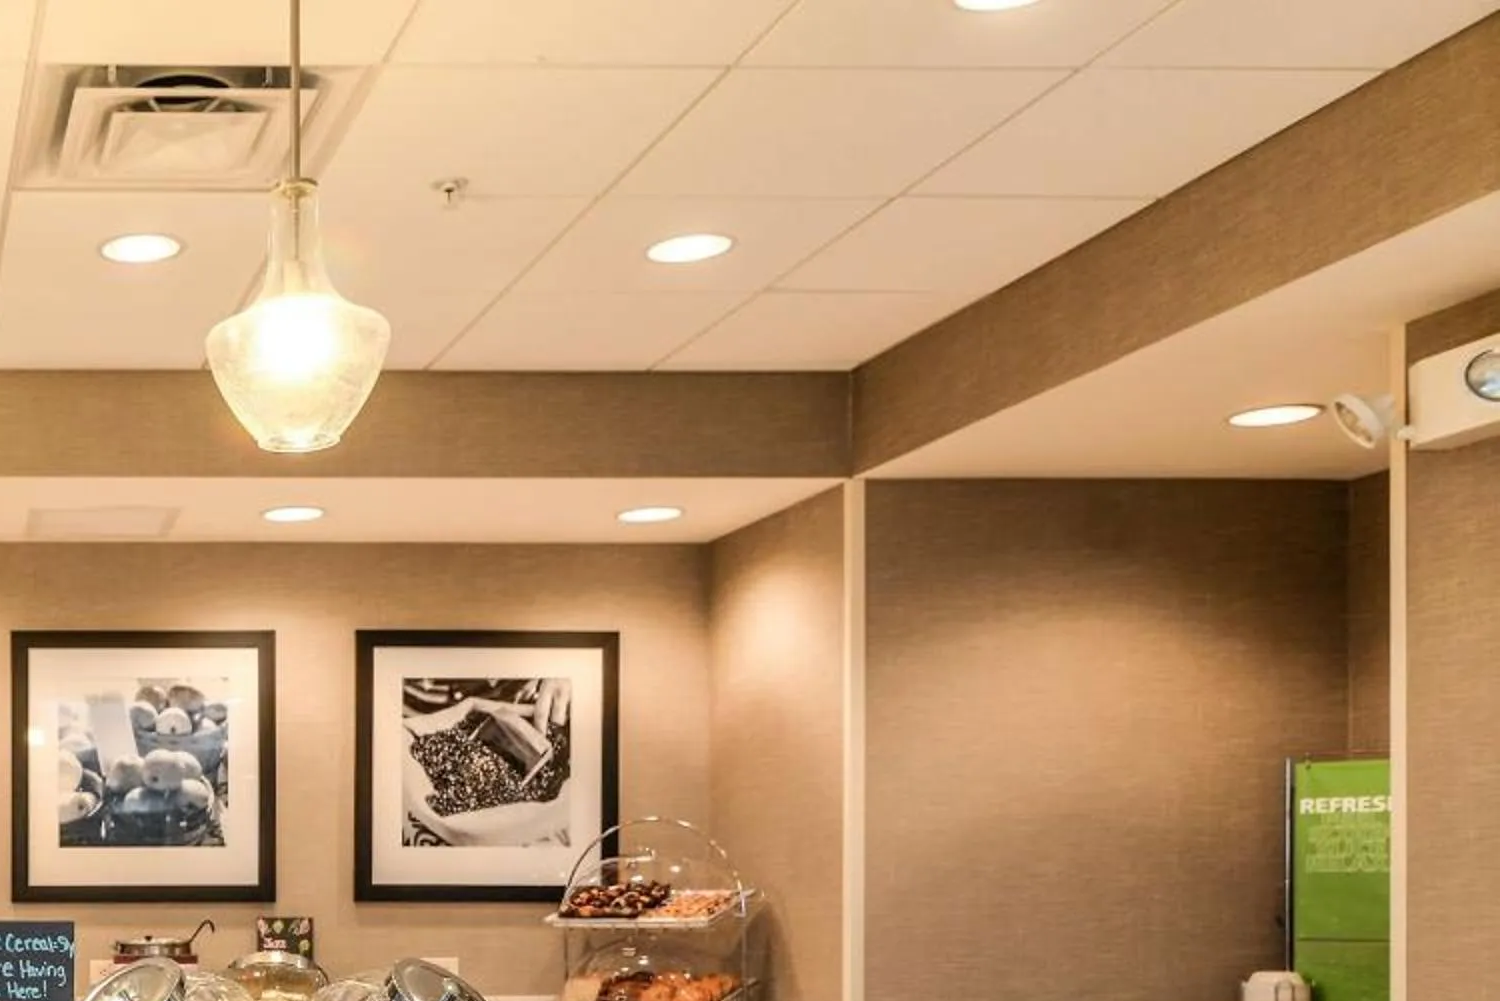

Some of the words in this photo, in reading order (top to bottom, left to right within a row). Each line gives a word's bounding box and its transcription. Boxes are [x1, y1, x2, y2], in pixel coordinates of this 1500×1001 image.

[1300, 795, 1392, 815] REFRES
[19, 959, 67, 987] Having
[7, 979, 48, 999] Here!
